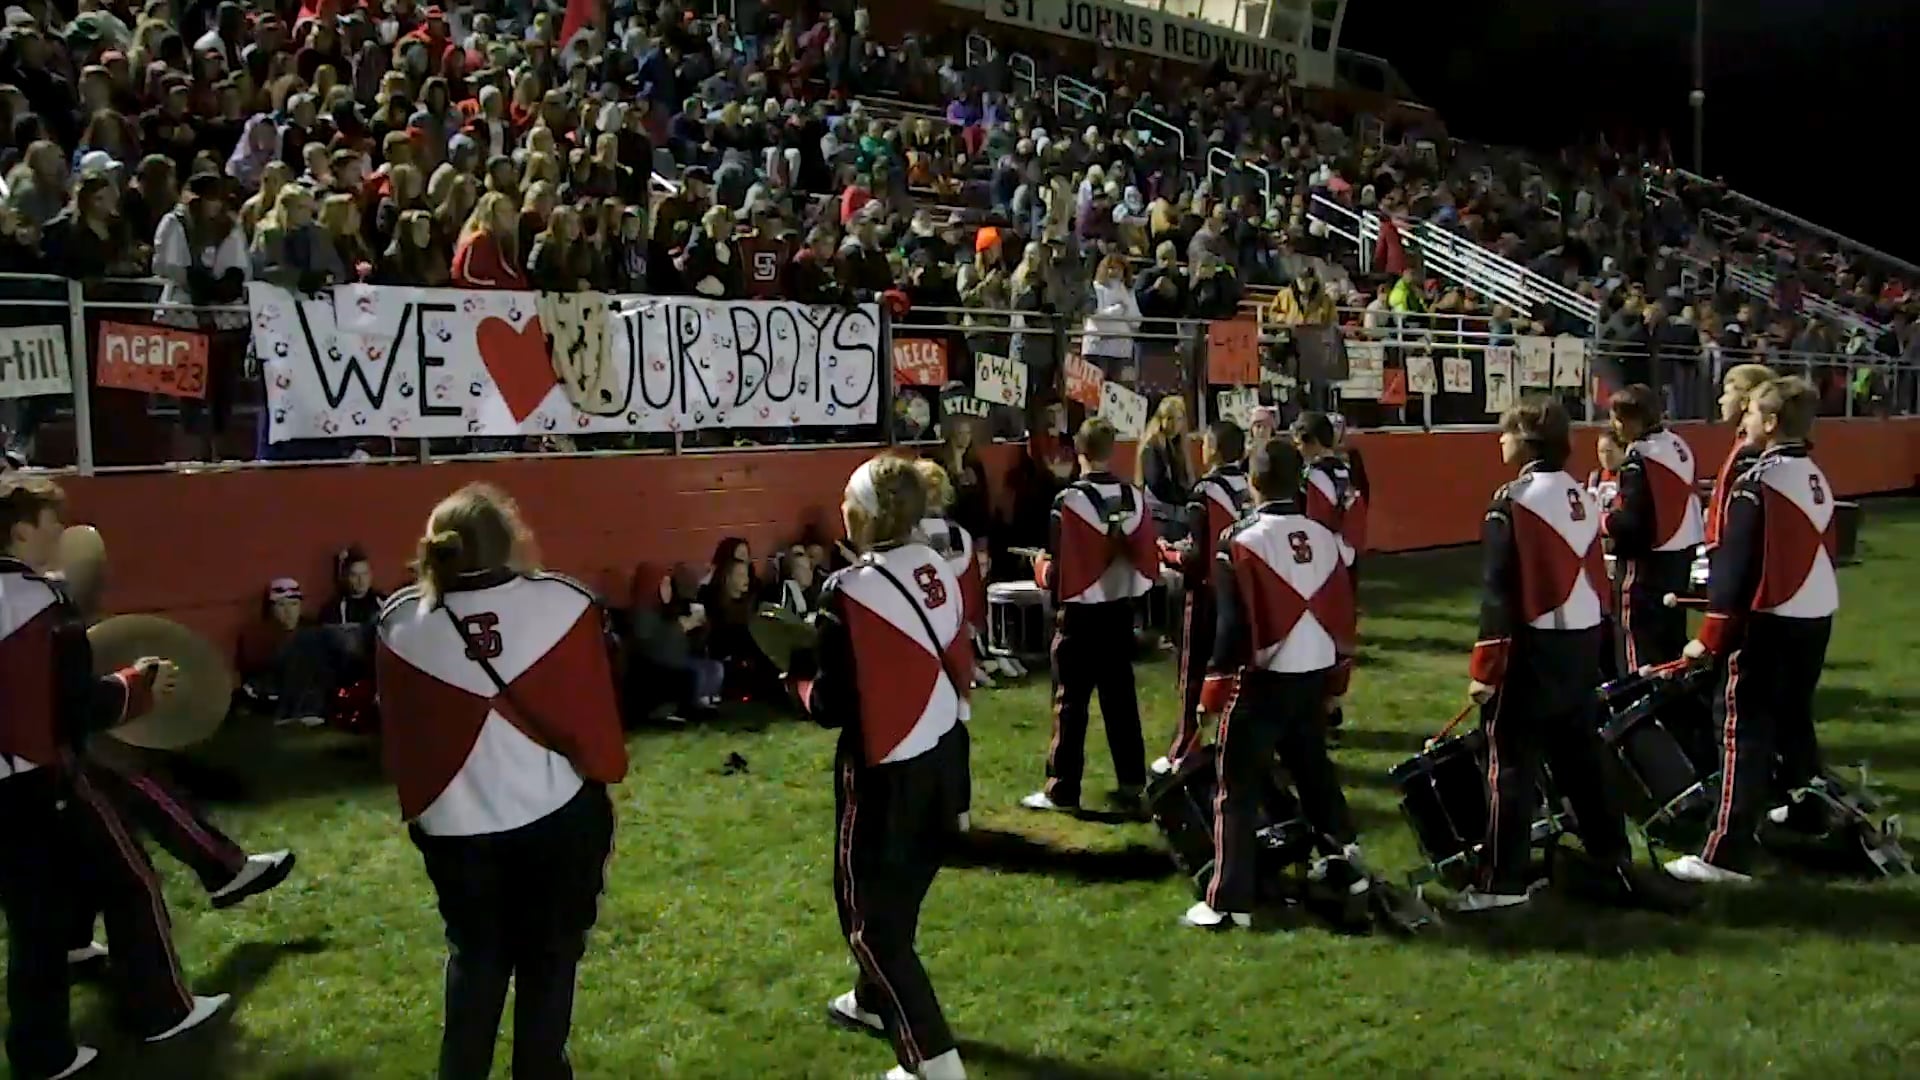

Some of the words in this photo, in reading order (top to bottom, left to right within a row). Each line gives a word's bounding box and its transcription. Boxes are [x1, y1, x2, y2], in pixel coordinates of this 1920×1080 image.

[1060, 0, 1154, 46] JOHNS
[1164, 22, 1298, 79] REDWINGS
[105, 333, 191, 367] near
[294, 301, 463, 416] WE
[729, 306, 875, 409] BOYS
